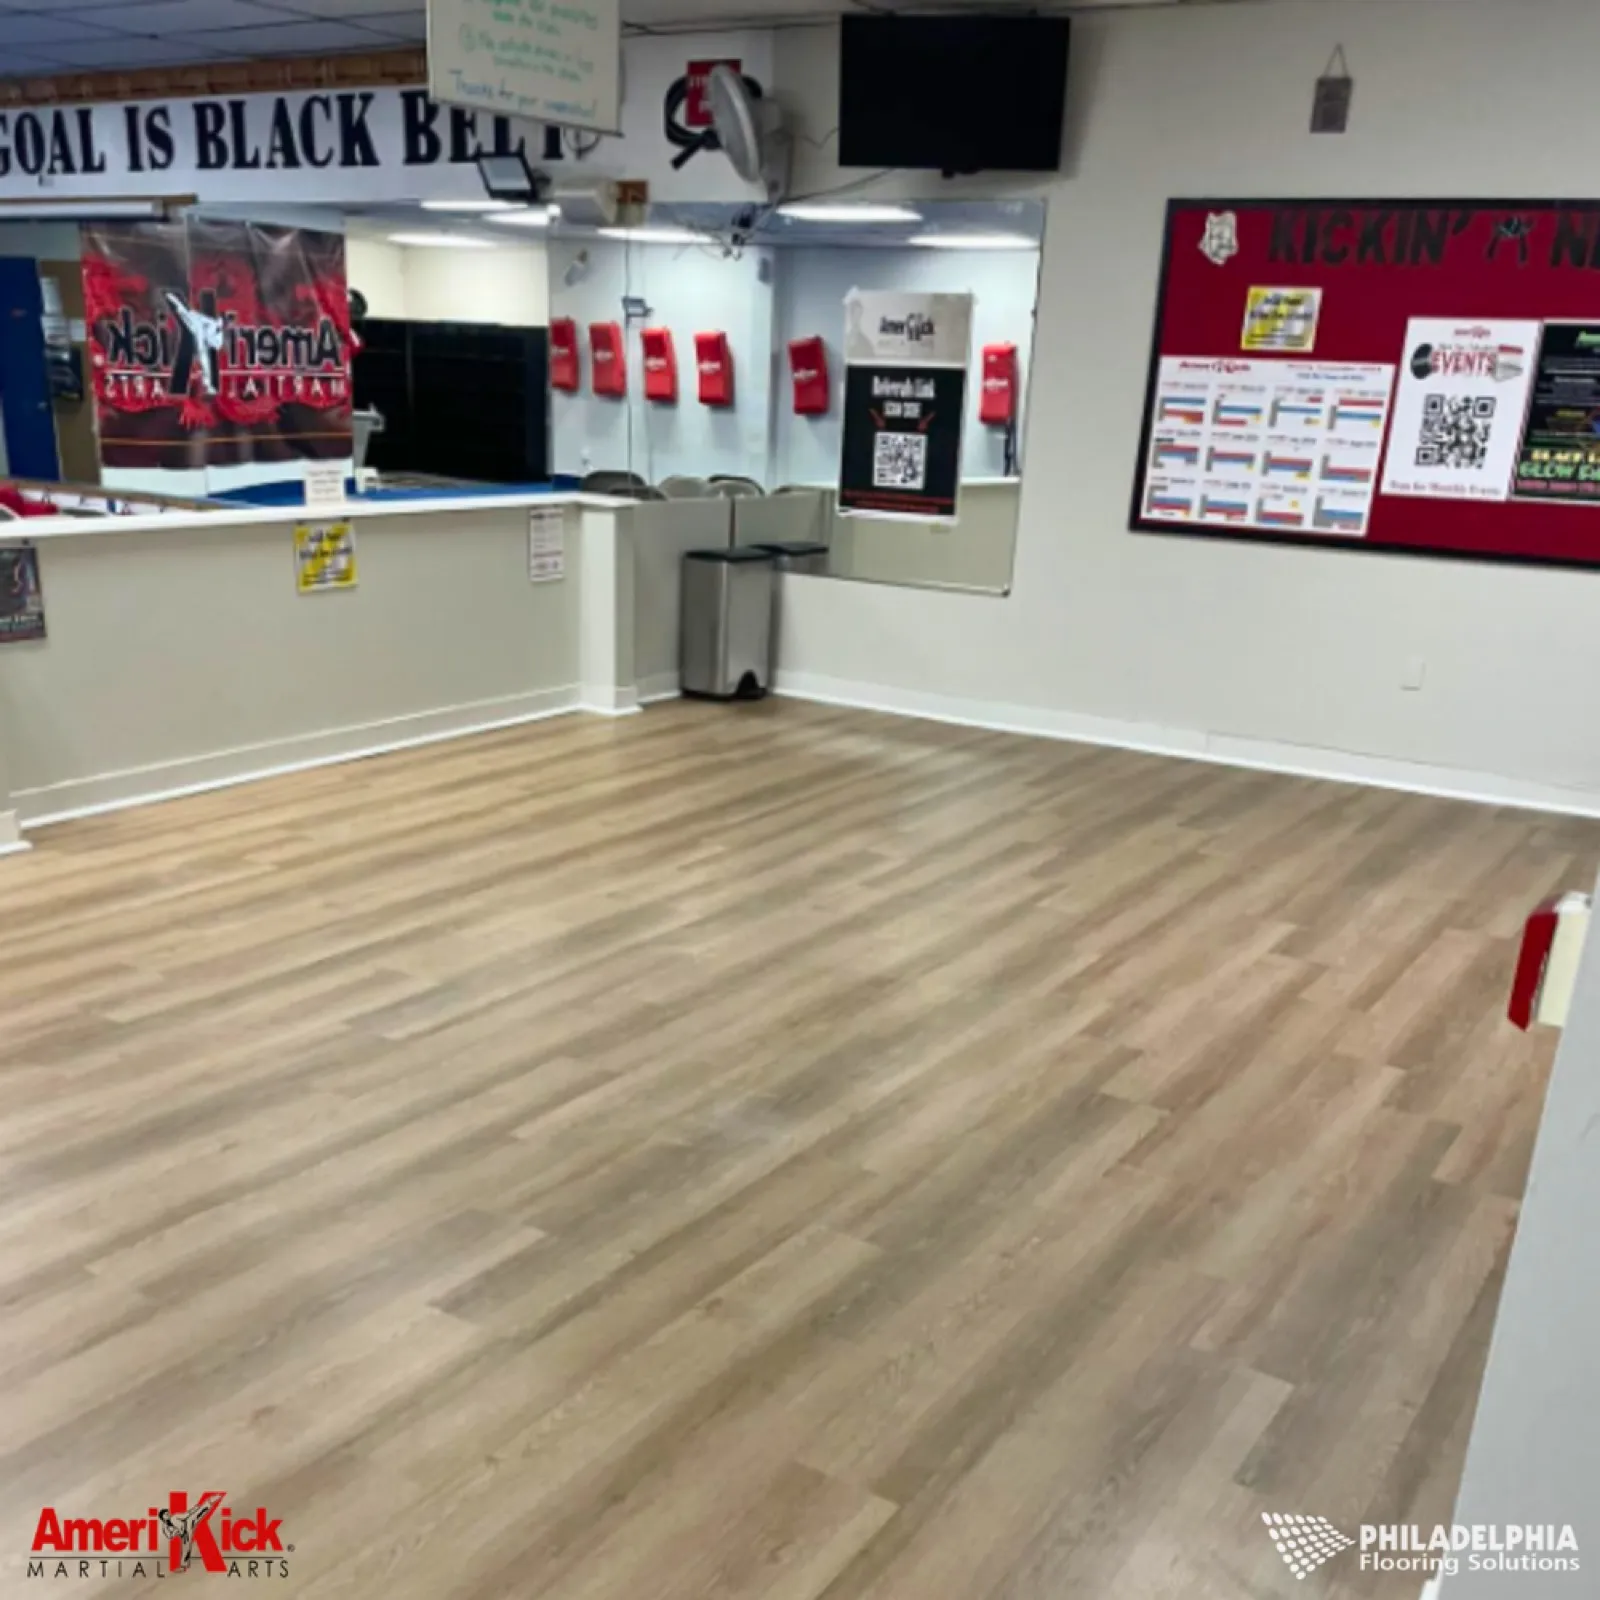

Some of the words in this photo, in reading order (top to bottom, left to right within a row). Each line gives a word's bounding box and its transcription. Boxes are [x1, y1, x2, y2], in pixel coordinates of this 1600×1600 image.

[124, 106, 175, 172] IS
[193, 93, 380, 170] BLACK
[1431, 352, 1497, 377] EVENTS
